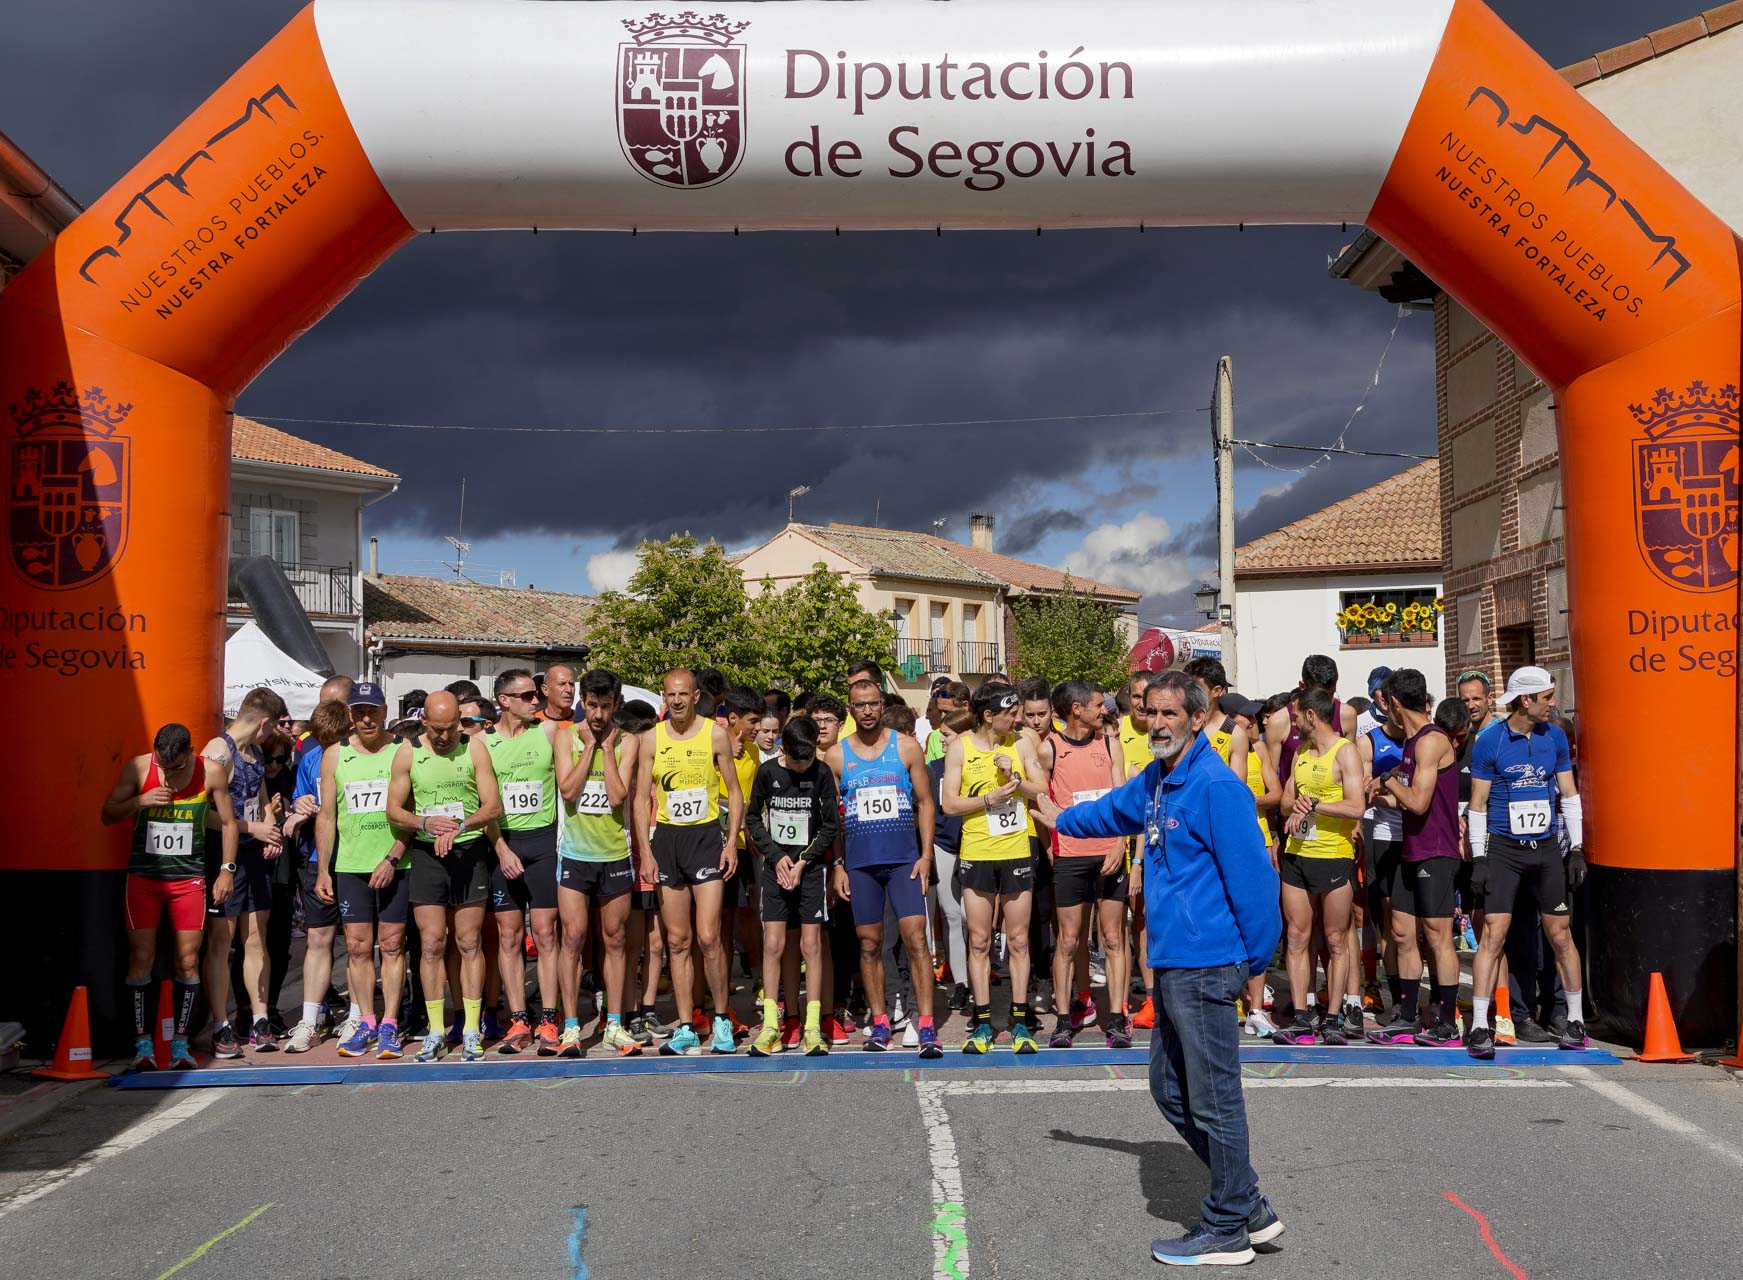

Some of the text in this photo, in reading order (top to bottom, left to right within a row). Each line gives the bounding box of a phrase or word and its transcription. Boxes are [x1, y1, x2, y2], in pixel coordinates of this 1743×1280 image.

[785, 46, 1134, 115] Diputación
[784, 125, 1136, 191] de Segovia
[120, 130, 325, 313] NUESTROS PUEBLOS.
[1440, 131, 1644, 318] NUESTROS PUEBLOS.
[155, 165, 328, 320] NUESTRA FORTALEZA
[1435, 166, 1607, 321] NUESTRA FORTALEZA
[26, 641, 146, 677] Segovia
[1629, 644, 1738, 677] de Seg
[352, 791, 382, 808] 177
[509, 793, 538, 808] 196
[580, 792, 609, 808] 222
[770, 796, 812, 808] FINISHER
[864, 798, 892, 814] 150
[672, 800, 702, 817] 287
[999, 811, 1018, 828] 82
[1518, 812, 1546, 828] 172
[777, 823, 797, 839] 79
[153, 834, 184, 850] 101
